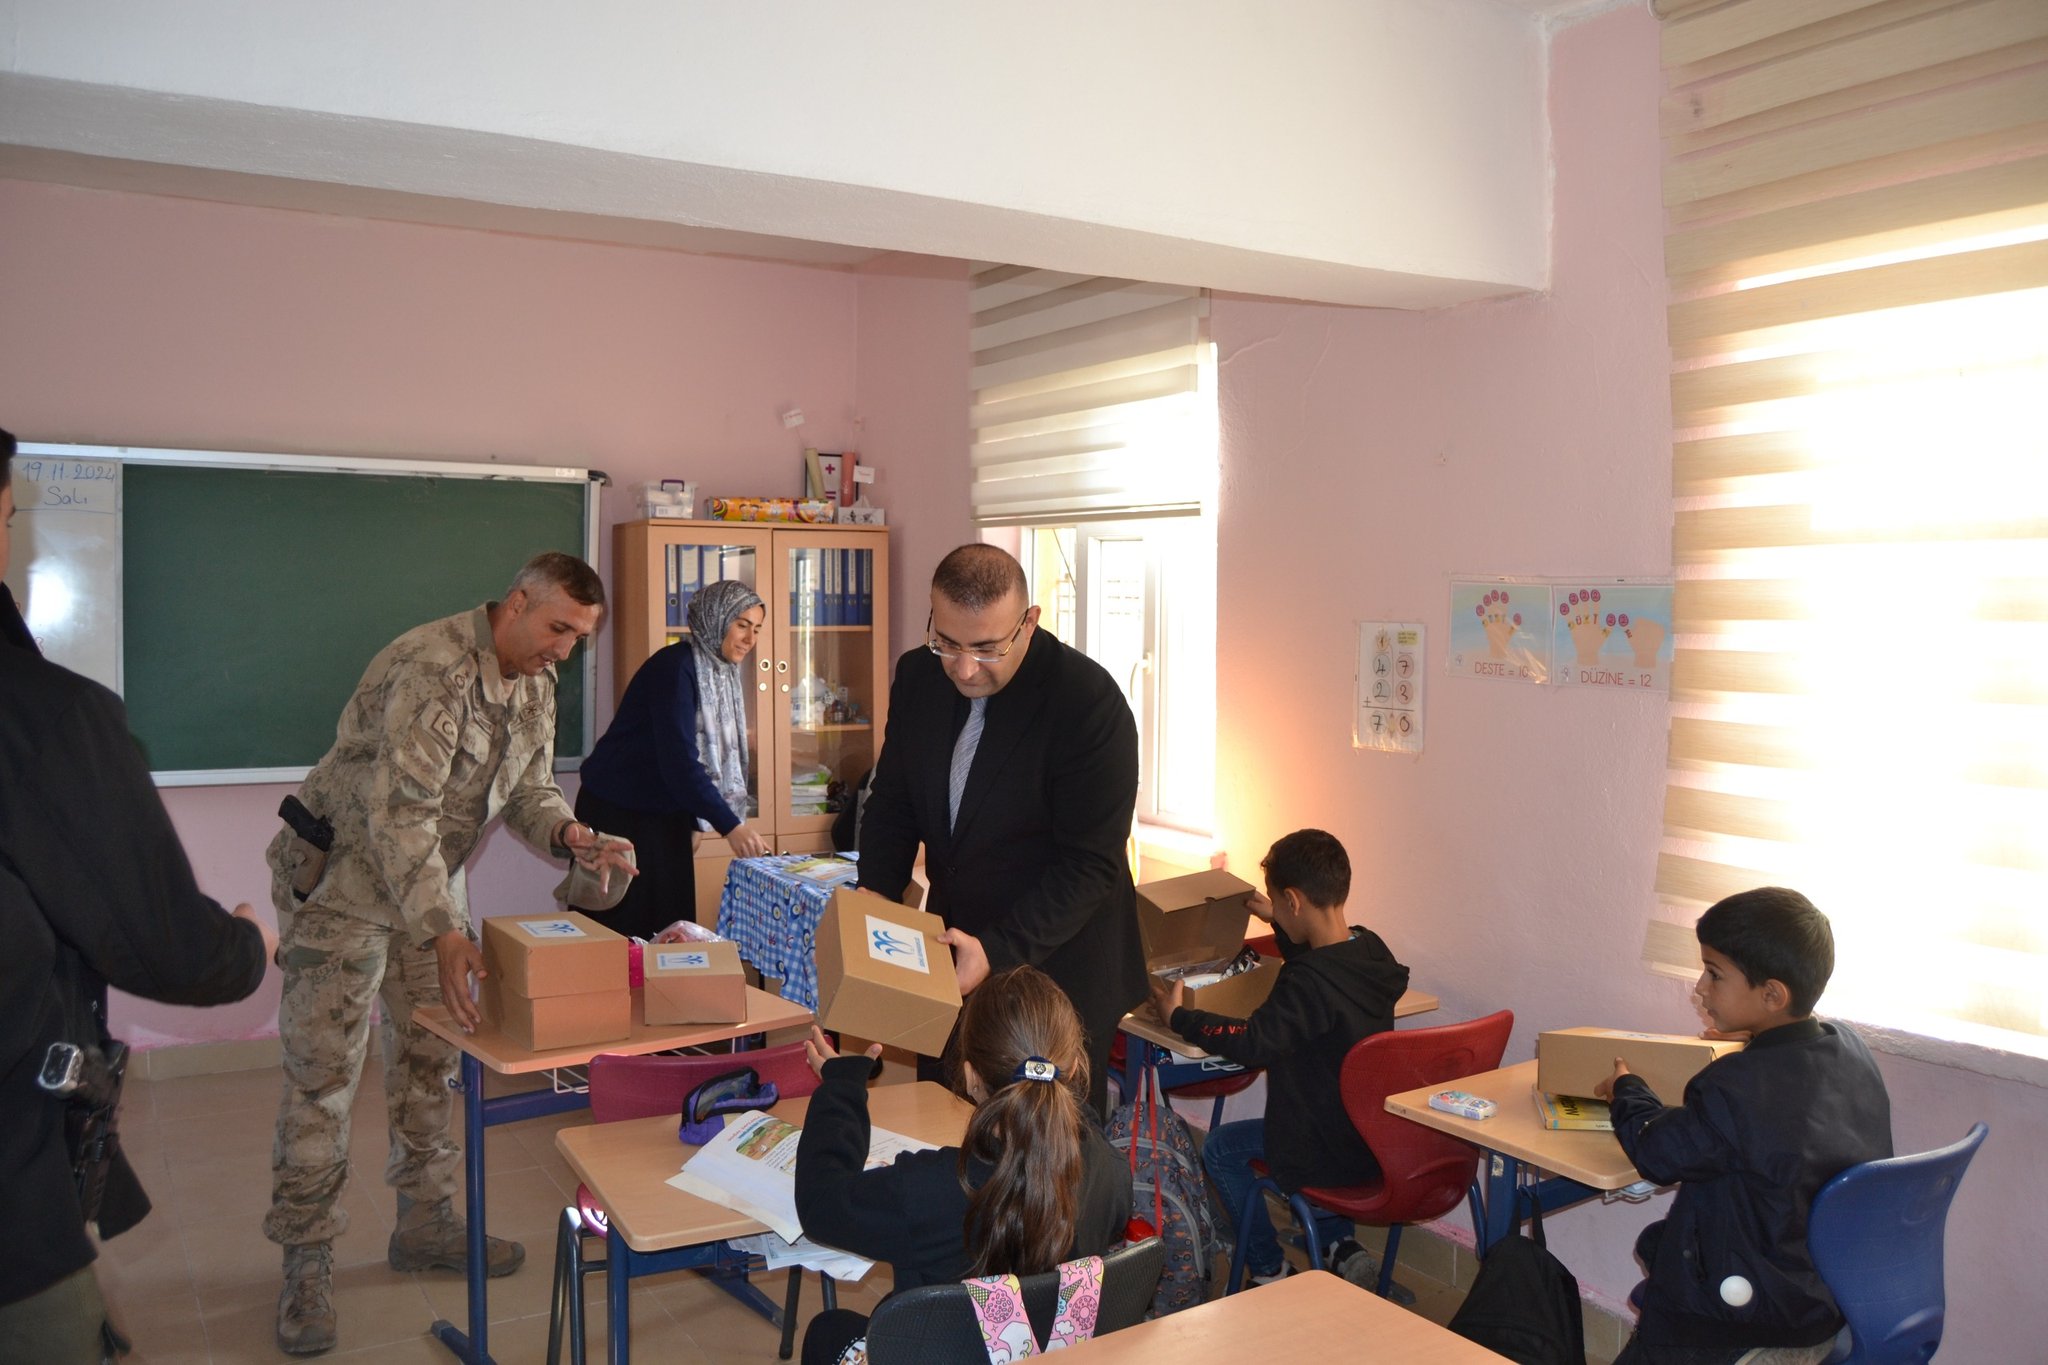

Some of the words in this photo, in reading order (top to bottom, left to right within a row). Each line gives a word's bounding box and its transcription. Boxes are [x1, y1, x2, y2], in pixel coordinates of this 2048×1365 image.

[1375, 658, 1386, 674] 4
[1398, 660, 1409, 675] 7
[1474, 661, 1505, 676] DESTE
[1580, 667, 1624, 686] DÜZİNE
[1640, 674, 1653, 688] 12
[1374, 681, 1388, 699] 2
[1371, 714, 1383, 731] 7
[1399, 715, 1411, 733] 0
